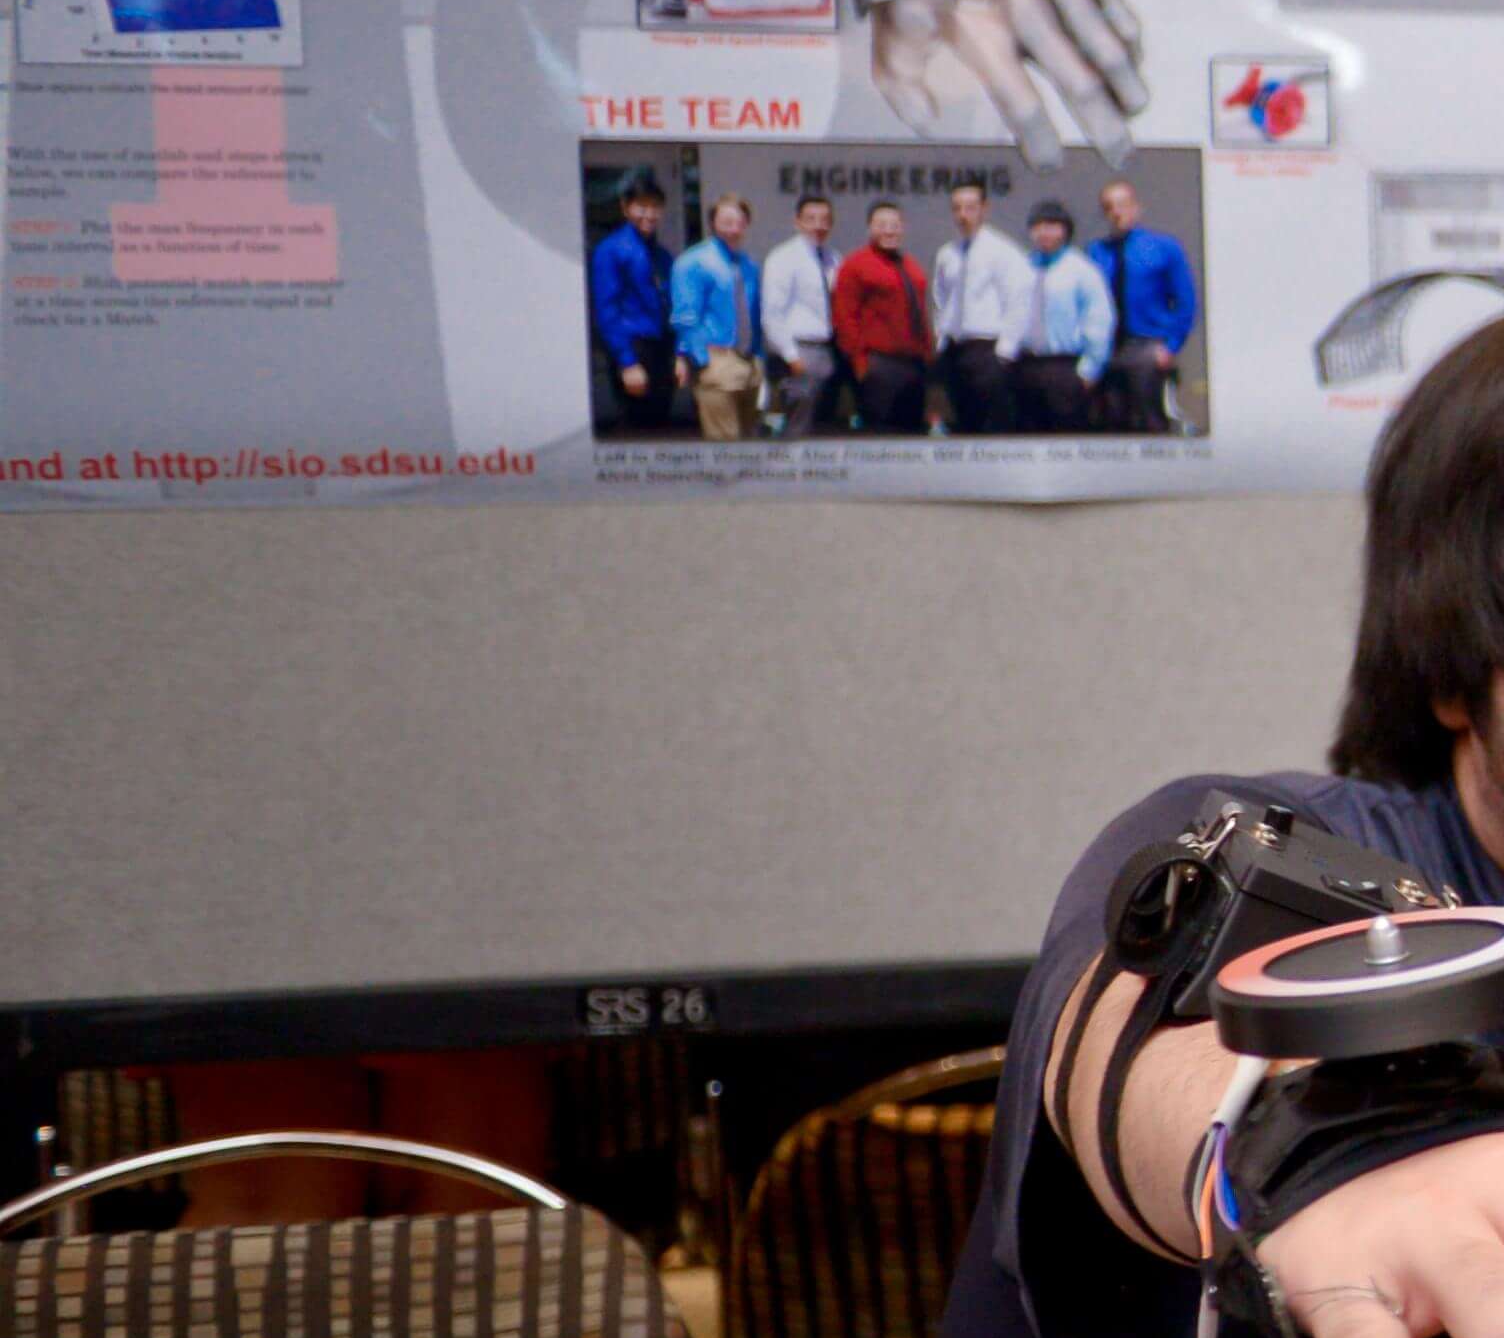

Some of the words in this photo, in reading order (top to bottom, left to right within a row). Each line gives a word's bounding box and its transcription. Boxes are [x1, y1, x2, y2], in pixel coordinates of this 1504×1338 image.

[581, 96, 665, 129] THE
[681, 96, 802, 130] TEAM
[80, 451, 120, 481] at
[132, 447, 535, 486] http://sio.sdsu.edu
